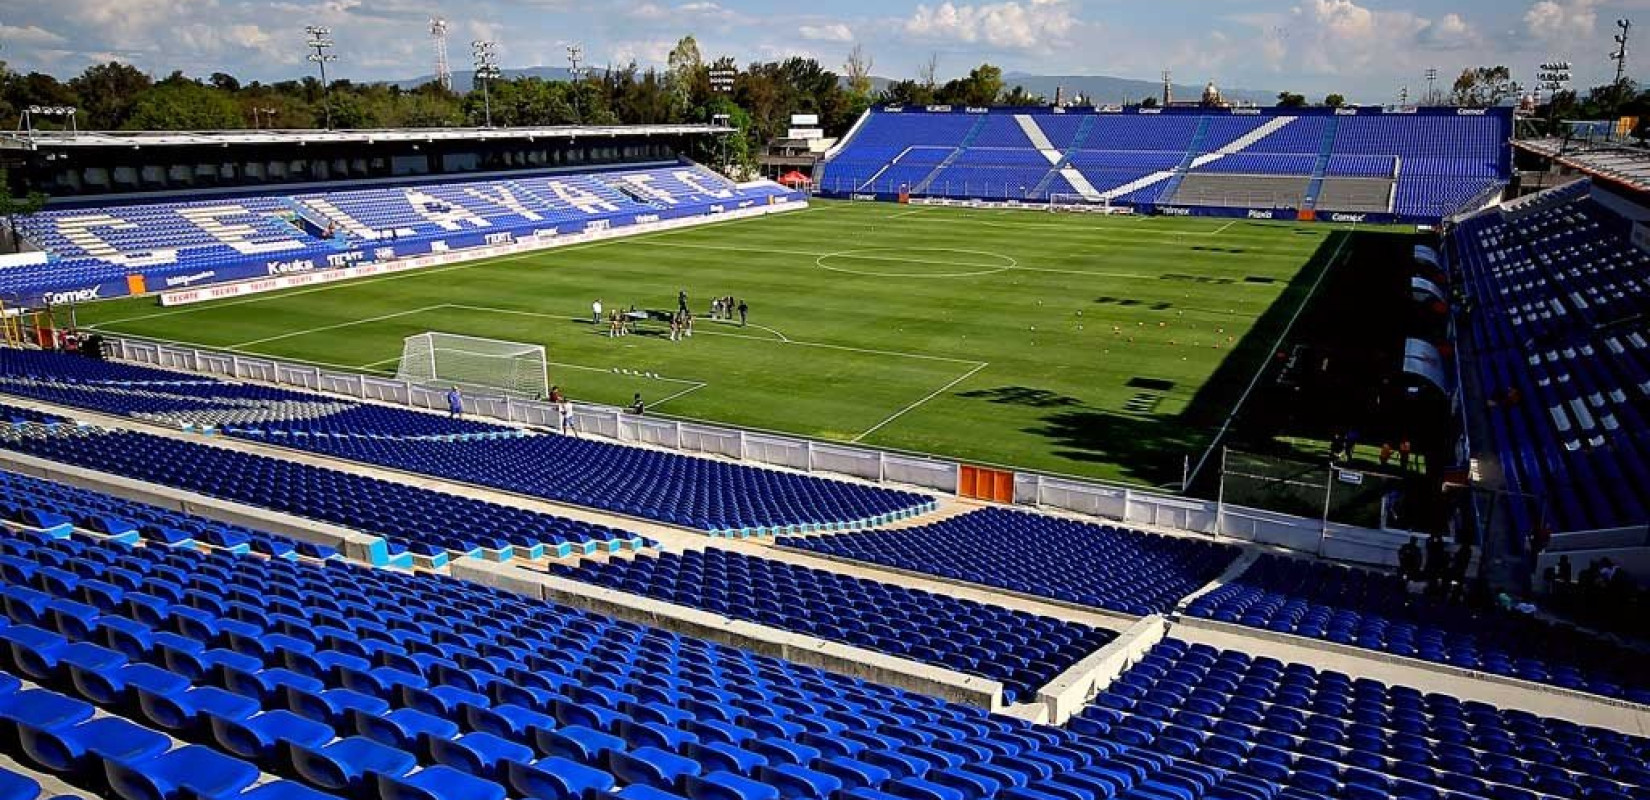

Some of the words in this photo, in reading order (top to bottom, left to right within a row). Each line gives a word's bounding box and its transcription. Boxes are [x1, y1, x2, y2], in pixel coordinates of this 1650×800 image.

[57, 181, 620, 266] CELAYA
[1332, 212, 1366, 222] Comex
[43, 284, 101, 305] Comex
[168, 292, 199, 303] TECATE
[212, 285, 239, 296] TECATE
[250, 280, 276, 290] TECATE
[287, 275, 312, 285] TECATE
